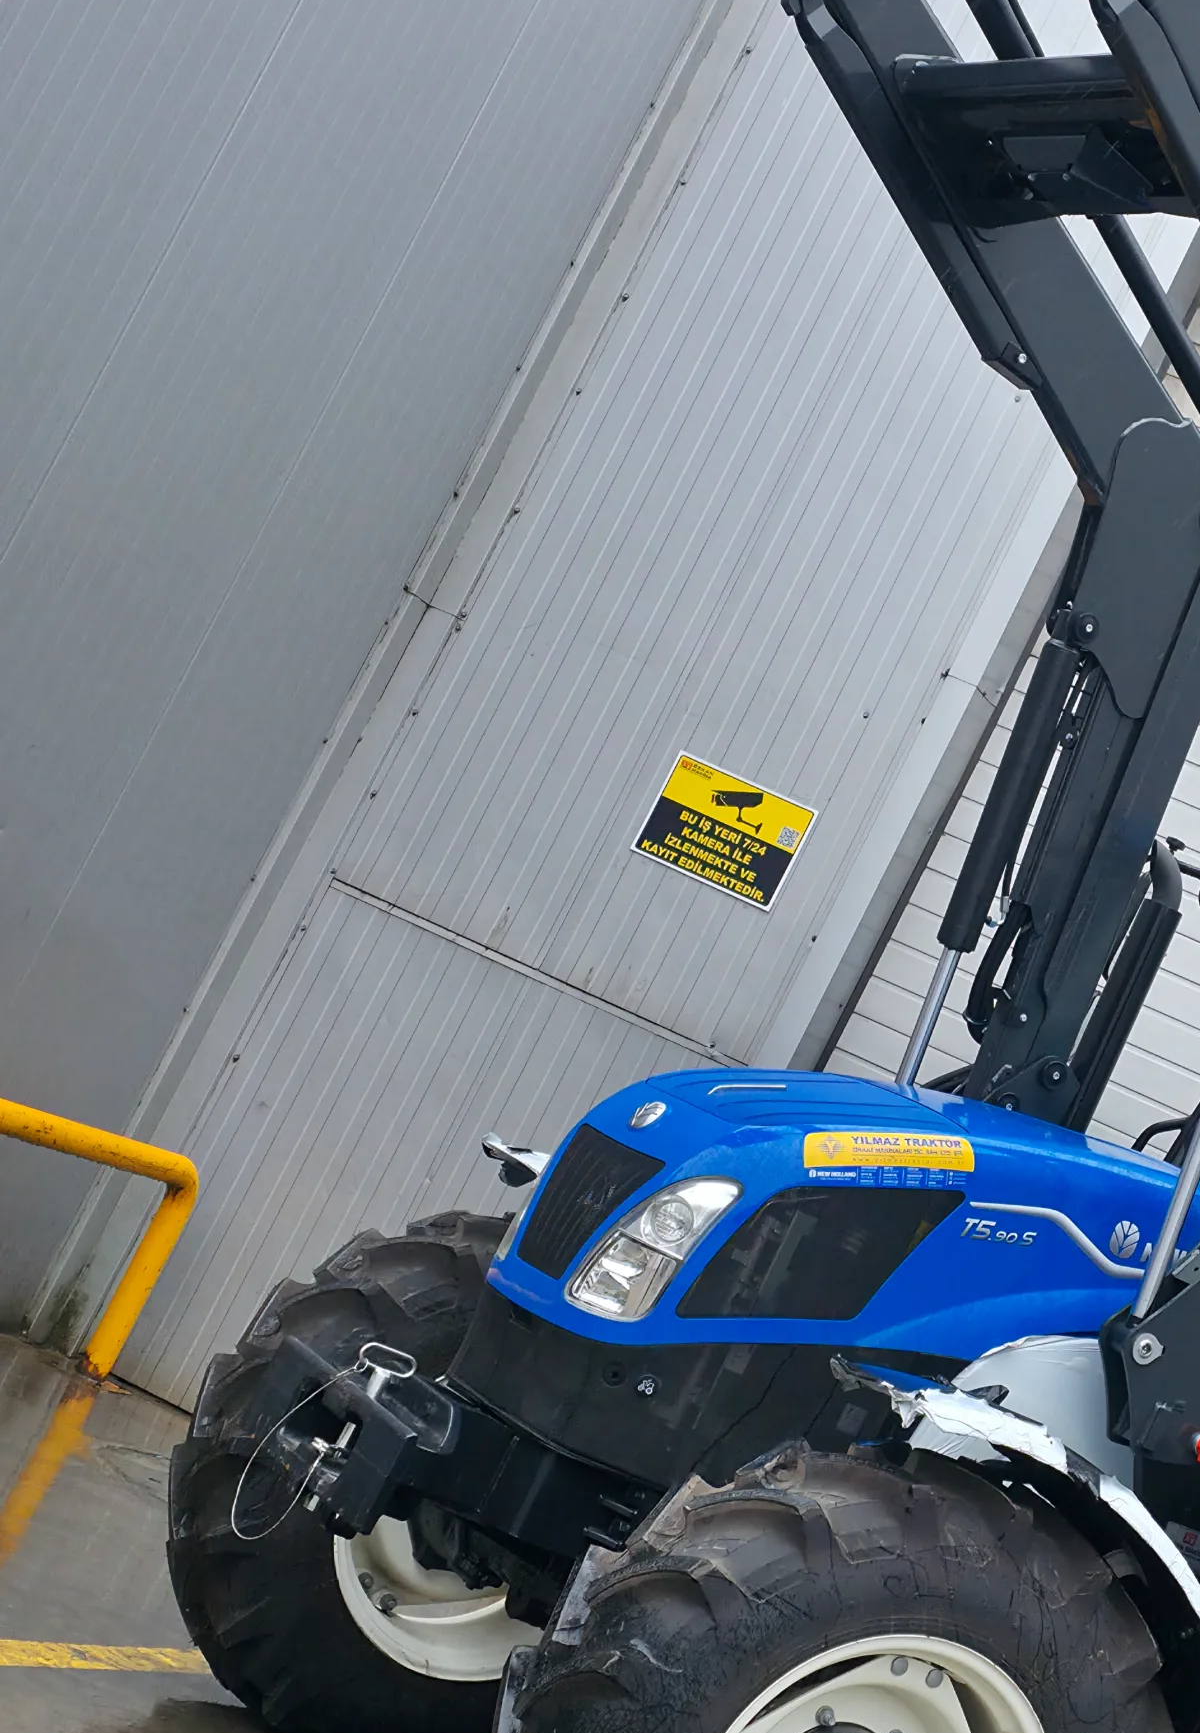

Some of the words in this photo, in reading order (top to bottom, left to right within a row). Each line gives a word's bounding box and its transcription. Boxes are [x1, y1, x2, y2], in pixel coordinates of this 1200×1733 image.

[679, 810, 698, 825] BU
[699, 817, 711, 833] İŞ
[714, 825, 742, 845] YERİ
[742, 838, 767, 857] 7/24
[681, 827, 730, 856] KAMERA
[732, 847, 753, 865] İLE
[641, 839, 678, 862] KAYIT
[677, 856, 764, 902] EDİLMEKTEDİR.
[664, 832, 739, 875] İZLENMEKTE
[740, 867, 757, 883] VE
[851, 1136, 900, 1147] YILMAZ
